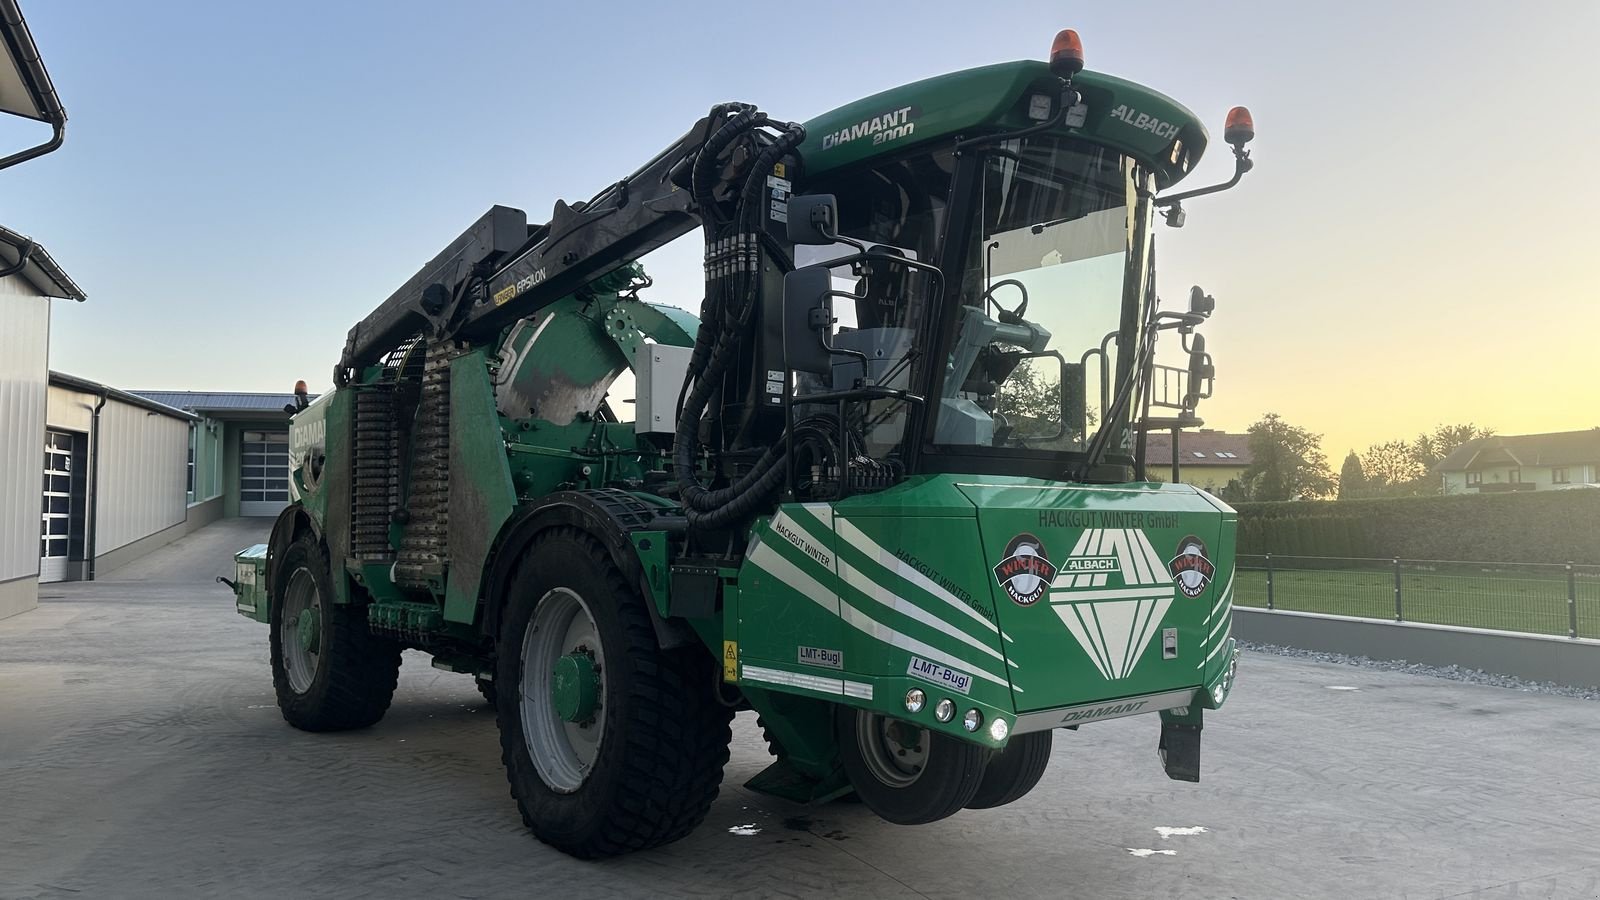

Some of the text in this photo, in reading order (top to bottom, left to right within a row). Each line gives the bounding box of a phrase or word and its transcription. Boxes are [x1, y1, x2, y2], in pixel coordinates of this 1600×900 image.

[873, 122, 914, 146] 2000
[1110, 104, 1179, 140] ALBACH
[516, 266, 546, 293] EPSILON
[1039, 510, 1179, 528] HACKGUT WINTER GmbH
[775, 522, 830, 567] HACKGUT WINTER
[1069, 560, 1114, 570] ALBACH
[895, 548, 994, 621] HACKGUT WINTER GmbH
[1007, 585, 1044, 604] HACKGUT
[1179, 580, 1205, 596] HACKGUT
[800, 647, 841, 665] LMT-Bugl
[912, 658, 970, 689] LMT-Bugl
